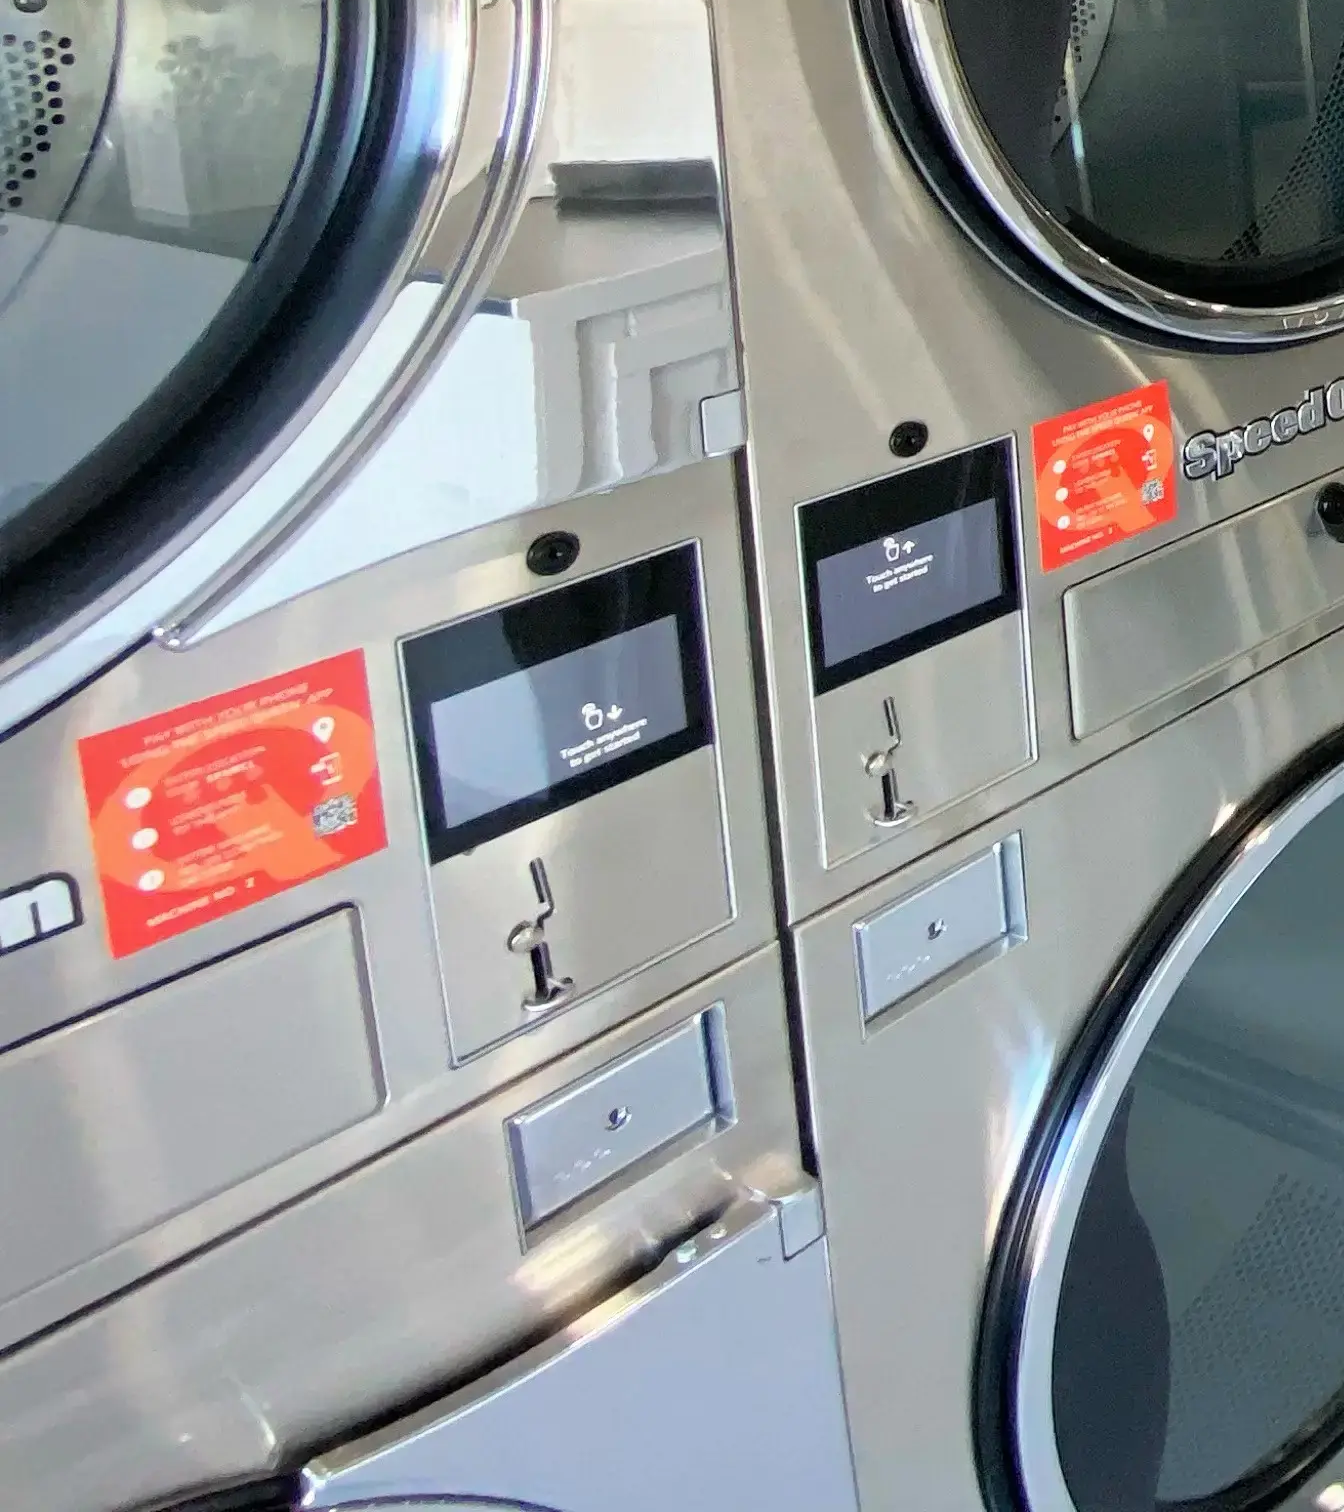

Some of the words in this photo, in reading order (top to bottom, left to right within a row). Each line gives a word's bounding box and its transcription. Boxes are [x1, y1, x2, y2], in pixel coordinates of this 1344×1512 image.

[1182, 384, 1327, 481] Speed
[865, 568, 893, 585] Touch
[893, 554, 934, 575] anywhere
[560, 739, 594, 759] Touch
[596, 718, 648, 744] anywhere
[569, 757, 583, 768] to
[583, 748, 601, 764] get
[603, 730, 640, 753] started
